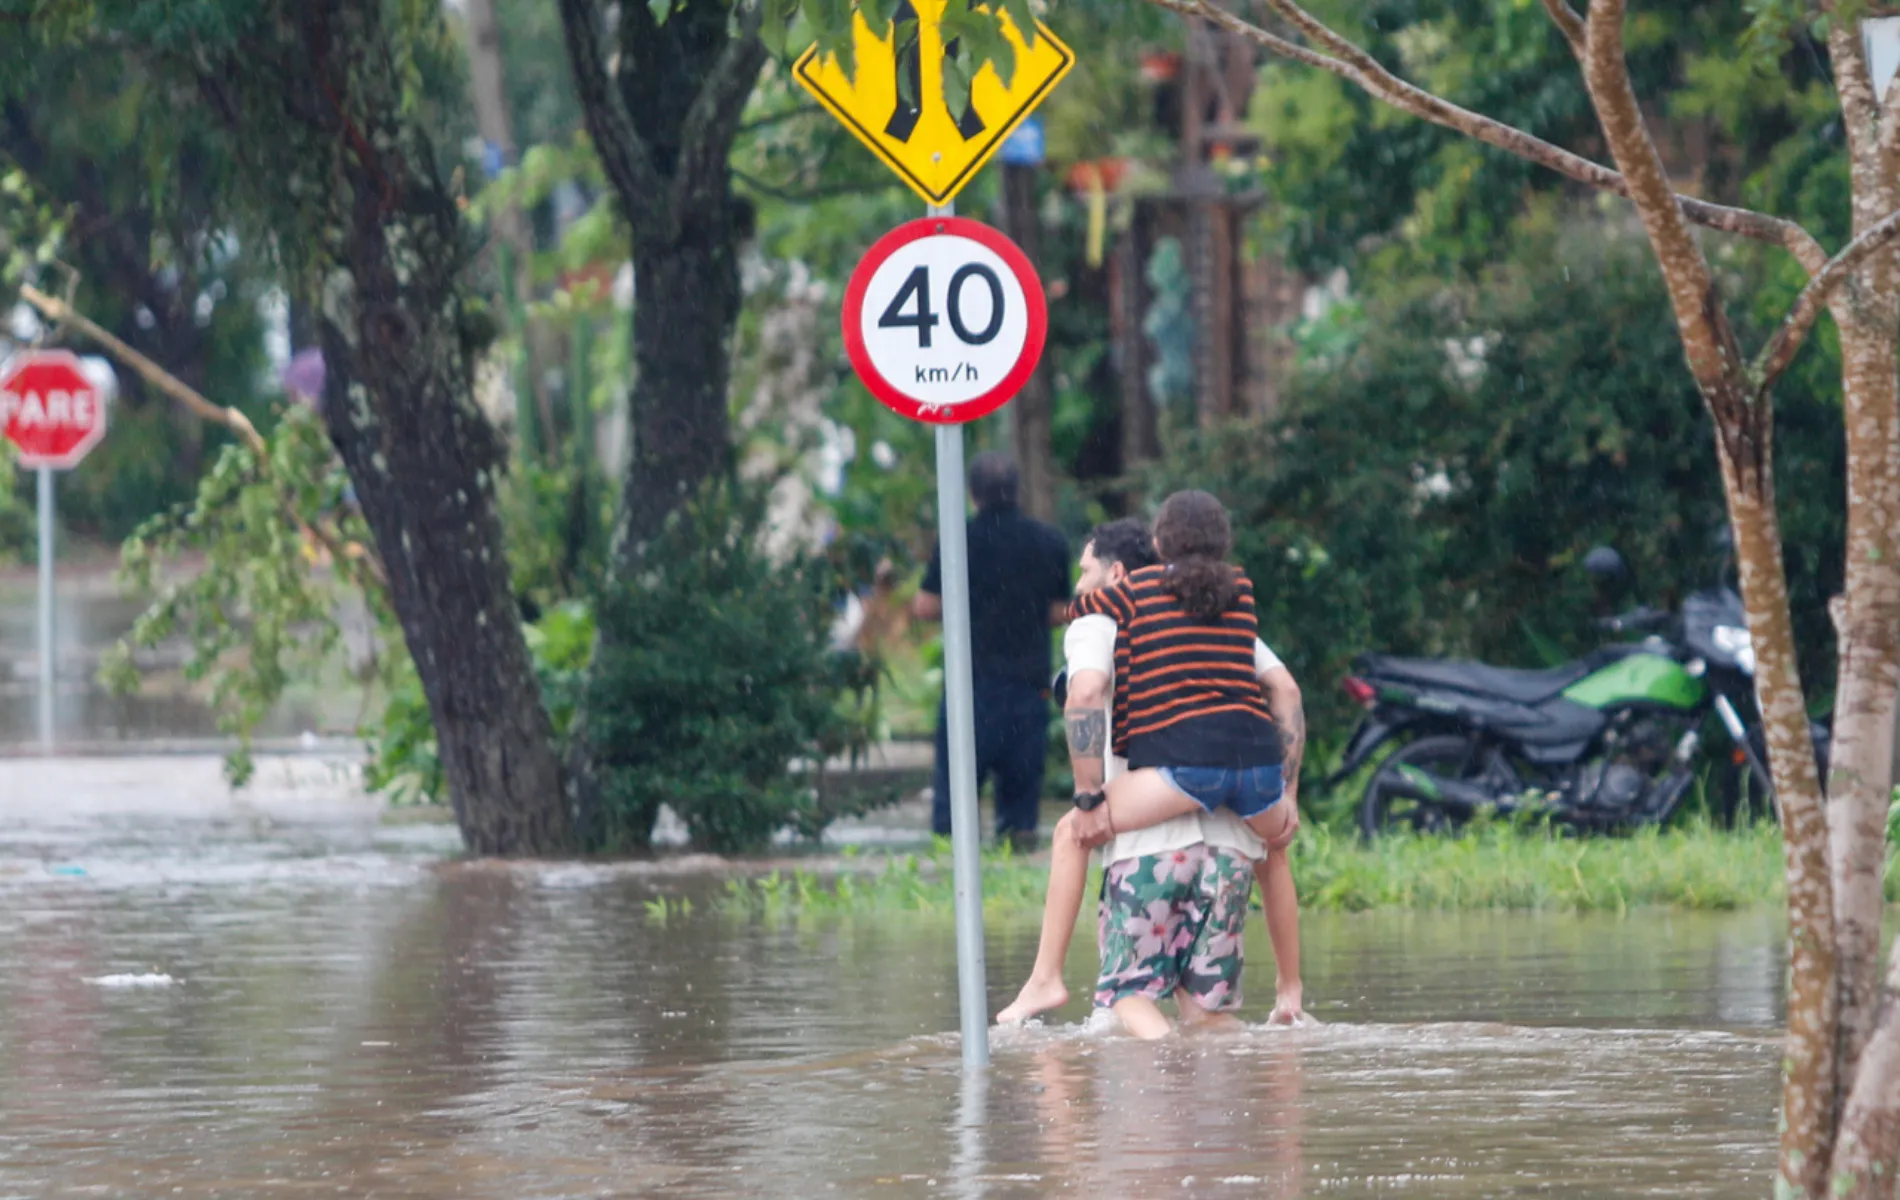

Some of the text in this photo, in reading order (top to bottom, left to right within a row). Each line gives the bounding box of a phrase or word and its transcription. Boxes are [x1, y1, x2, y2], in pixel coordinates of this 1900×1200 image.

[878, 262, 1005, 348] 40
[915, 362, 979, 384] km/h
[0, 389, 94, 429] PARE
